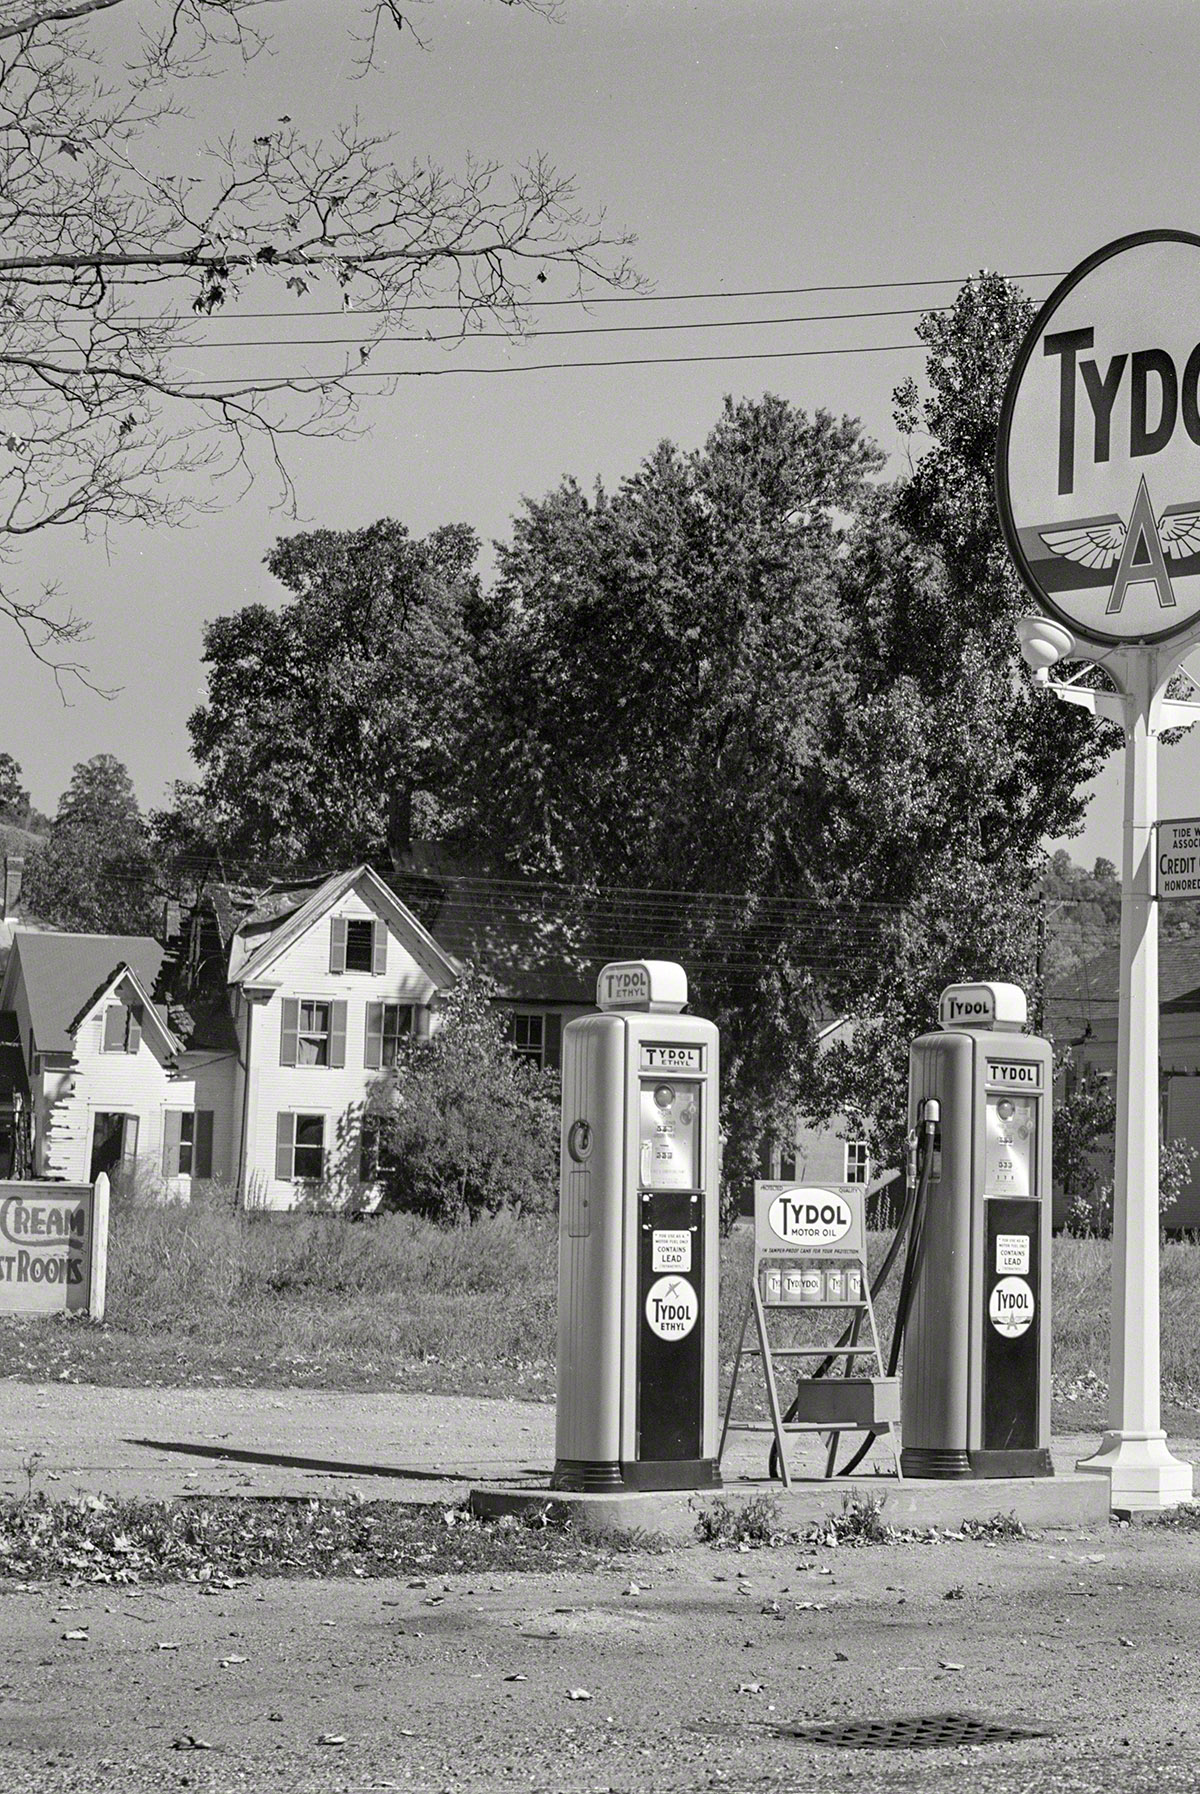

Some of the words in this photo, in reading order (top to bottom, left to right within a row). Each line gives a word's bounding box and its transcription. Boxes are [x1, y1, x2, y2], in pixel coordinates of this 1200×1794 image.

[1173, 828, 1191, 838] TIDE
[1160, 854, 1196, 875] CREDIT
[606, 973, 646, 998] TYDOL
[616, 988, 645, 997] ETHYL
[948, 997, 989, 1019] TYDOL
[646, 1049, 694, 1065] TYDOL
[990, 1066, 1033, 1081] TYDOL
[0, 1196, 85, 1250] CREAM
[779, 1198, 847, 1235] TYDOL
[662, 1254, 682, 1263] LEAD
[652, 1299, 691, 1323] TYDOL
[996, 1290, 1029, 1312] TYDOL
[661, 1323, 685, 1331] ETHYL
